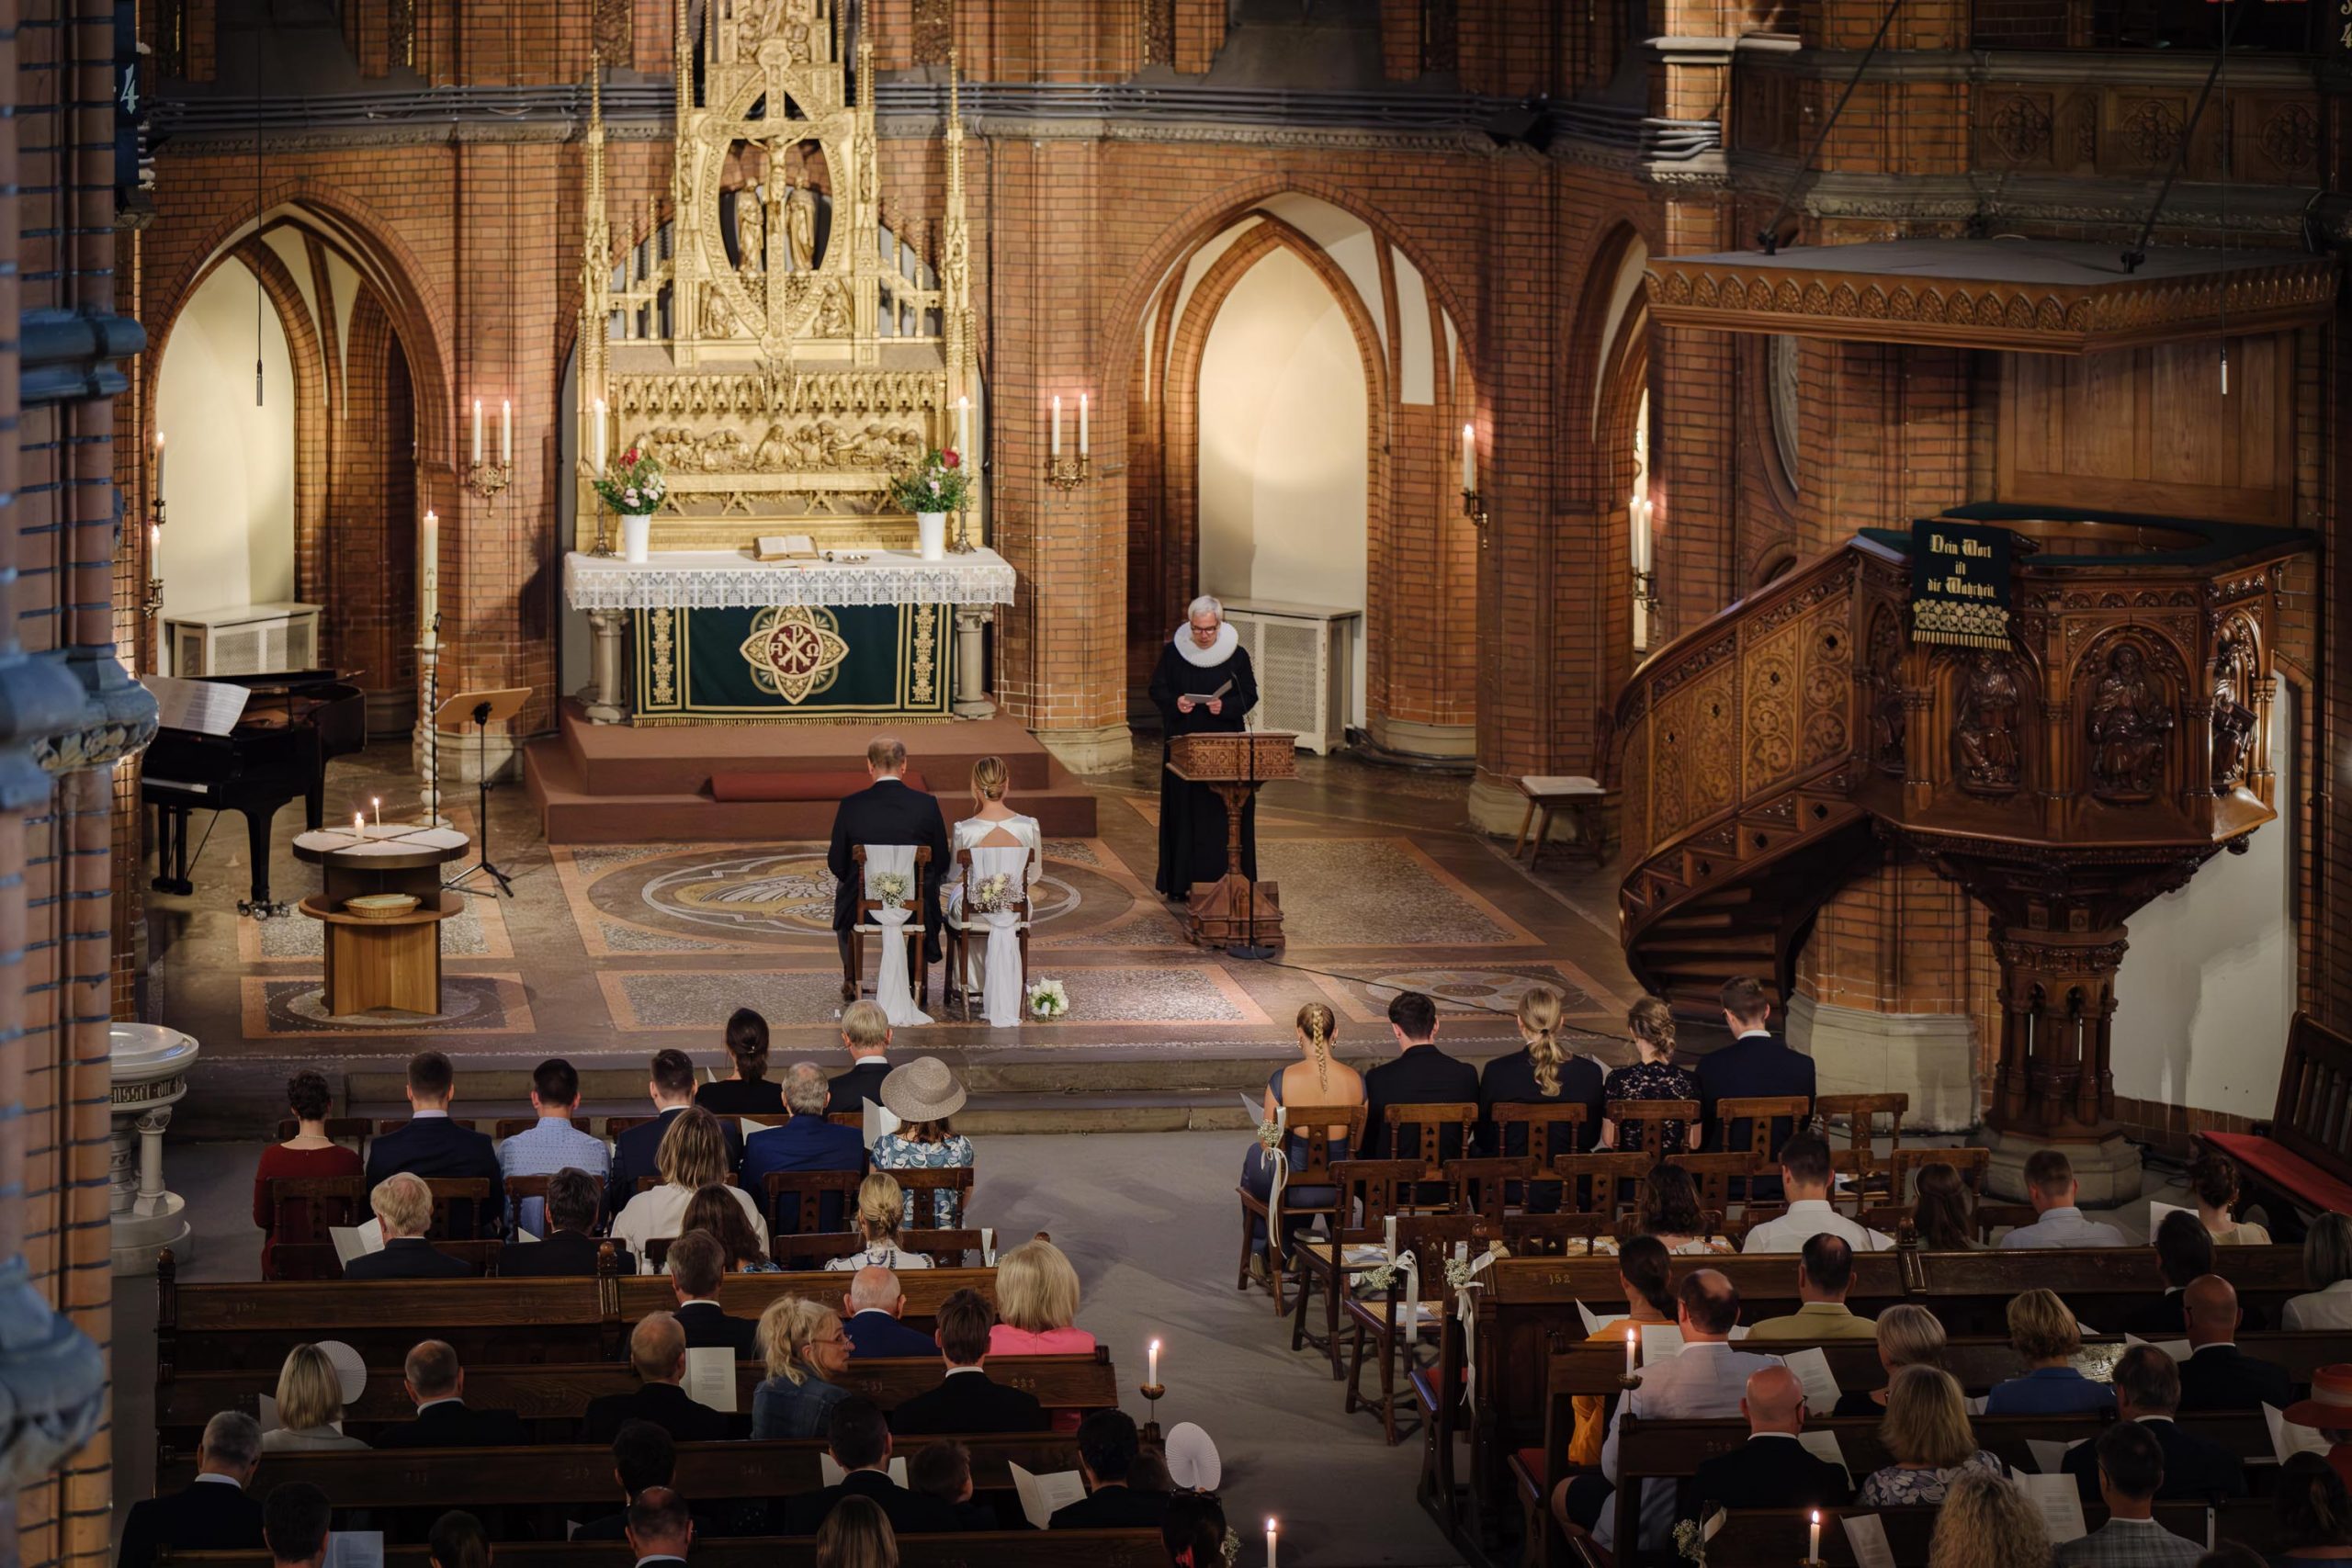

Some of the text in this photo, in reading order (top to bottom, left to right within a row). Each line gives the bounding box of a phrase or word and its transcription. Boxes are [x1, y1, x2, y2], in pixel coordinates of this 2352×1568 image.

[1930, 534, 1992, 558] Dein Wort
[1928, 579, 1941, 592] die
